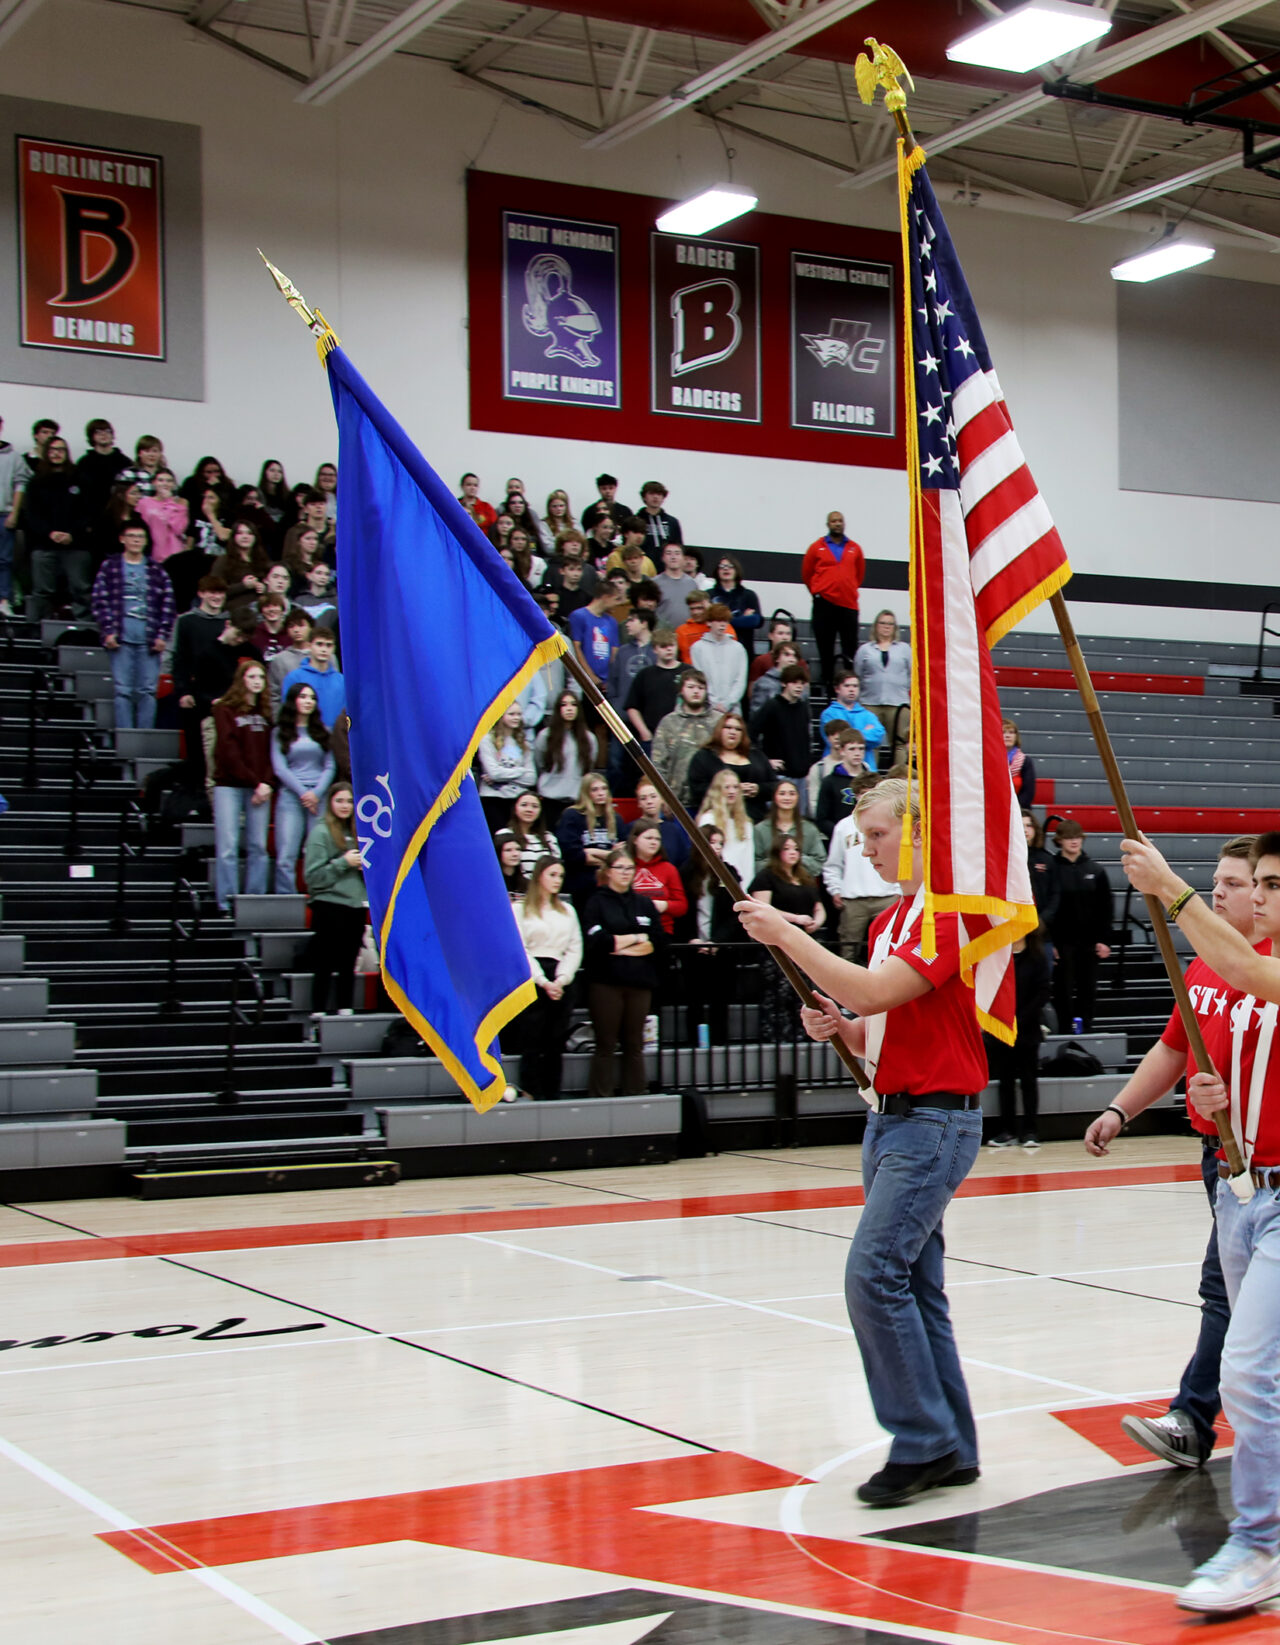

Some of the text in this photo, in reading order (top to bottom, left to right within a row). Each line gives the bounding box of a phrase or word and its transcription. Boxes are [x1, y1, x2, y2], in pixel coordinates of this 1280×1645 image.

[29, 150, 152, 188] BURLINGTON
[46, 184, 139, 306] B
[508, 222, 614, 252] BELOIT MEMORIAL
[676, 244, 736, 270] BADGER
[849, 269, 890, 288] CENTRAL
[53, 316, 135, 346] DEMONS
[671, 278, 742, 377] B
[511, 371, 614, 397] PURPLE KNIGHTS
[672, 386, 742, 412] BADGERS
[812, 401, 875, 426] FALCONS
